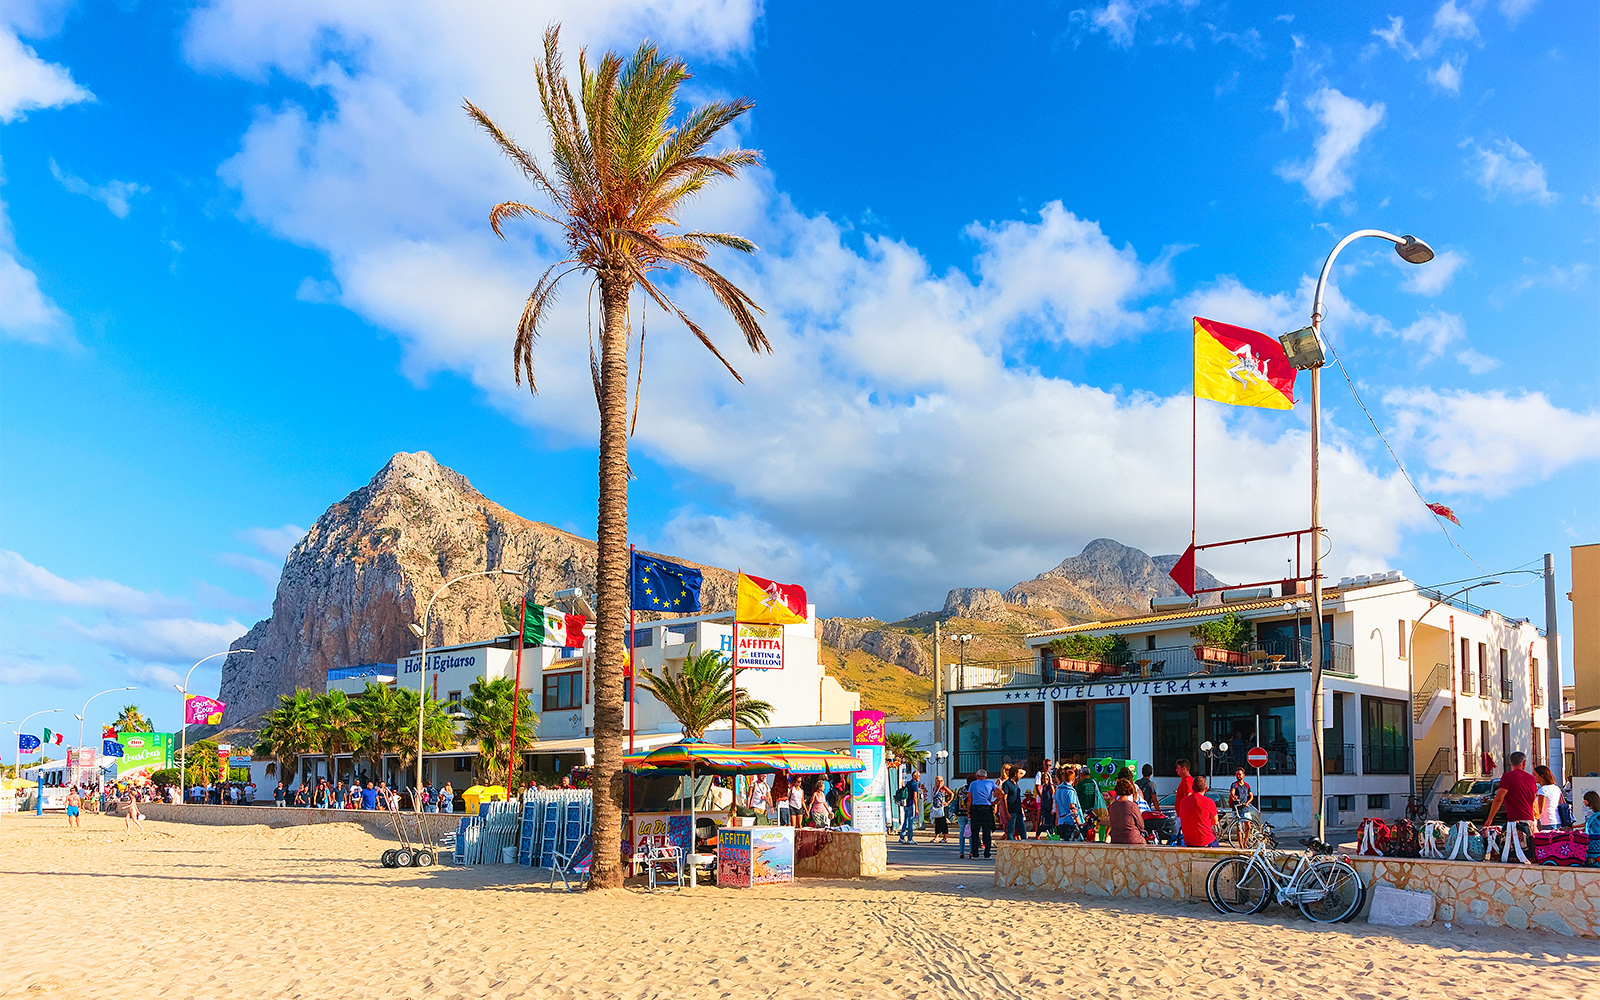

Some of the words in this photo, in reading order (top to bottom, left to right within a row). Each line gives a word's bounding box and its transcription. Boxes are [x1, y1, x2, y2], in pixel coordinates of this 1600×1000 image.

[739, 628, 748, 637] La
[748, 627, 767, 638] Dolce
[768, 628, 781, 638] Vita
[739, 639, 781, 650] AFFITTA
[404, 656, 431, 673] Hotel
[433, 655, 475, 672] Egitarso
[738, 658, 781, 666] OMBRELLONI
[1036, 685, 1095, 700] HOTEL
[1105, 680, 1191, 697] RIVIERA
[191, 701, 208, 709] Cous
[797, 761, 811, 771] Dolce
[812, 762, 822, 771] Vita
[851, 761, 862, 769] Vita
[638, 820, 652, 836] La
[719, 832, 751, 846] AFFITTA
[719, 848, 750, 860] LETTINI
